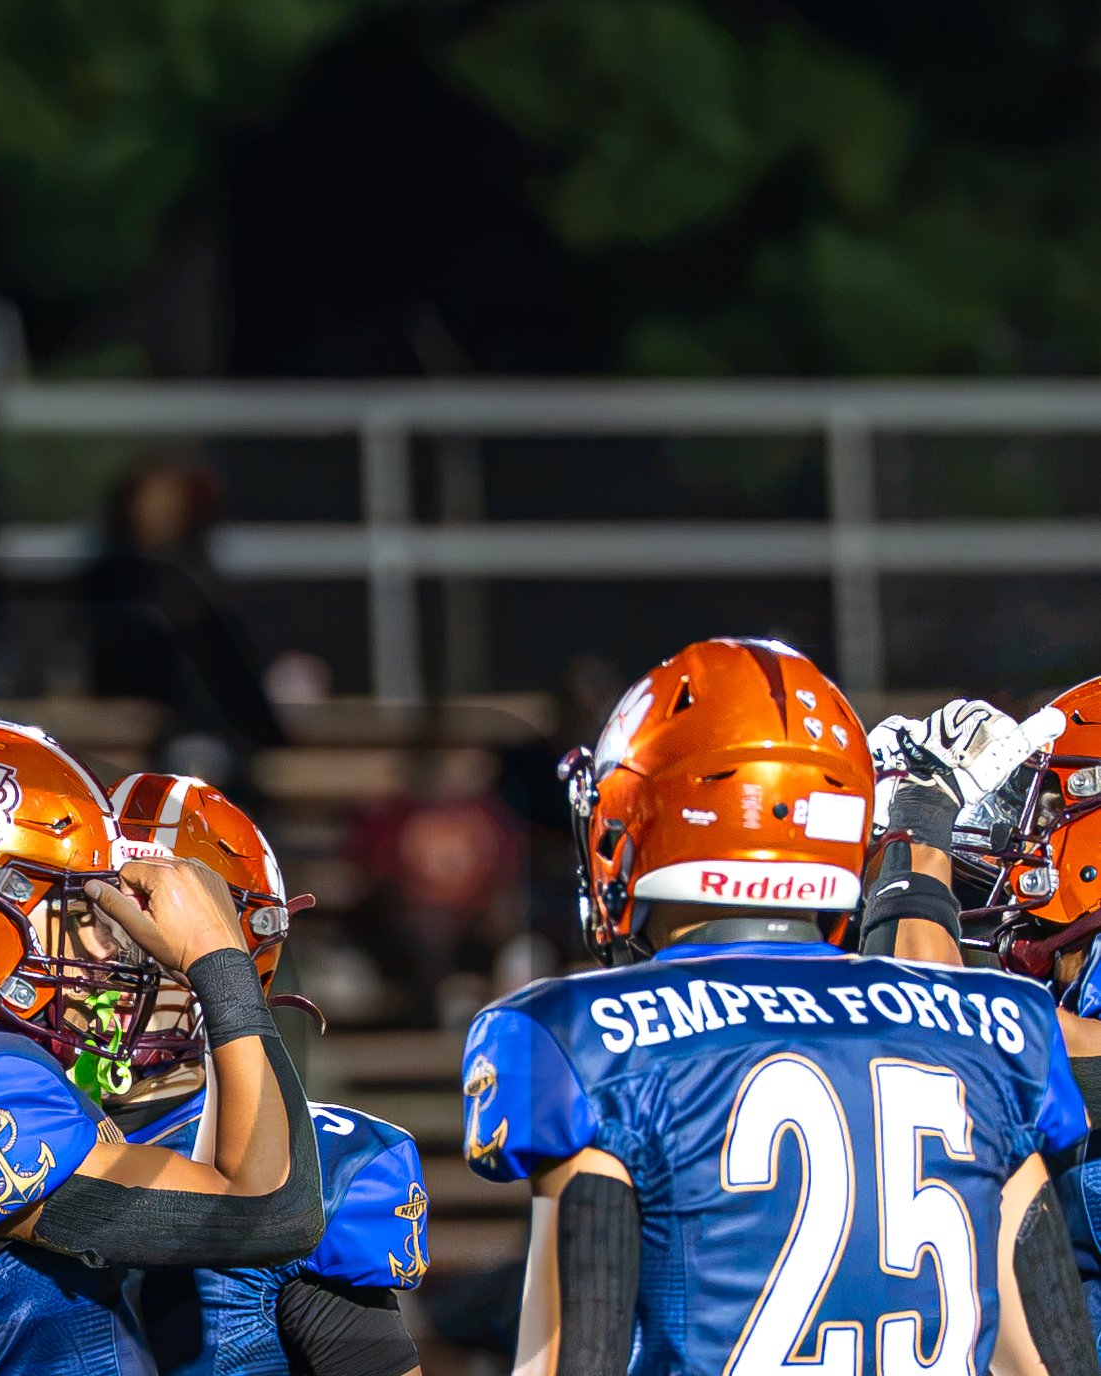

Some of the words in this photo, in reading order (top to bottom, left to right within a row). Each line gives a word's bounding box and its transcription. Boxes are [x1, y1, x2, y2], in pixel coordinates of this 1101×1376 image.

[700, 870, 837, 901] Riddell
[590, 979, 835, 1056] SEMPER
[835, 980, 1027, 1057] FORTIS
